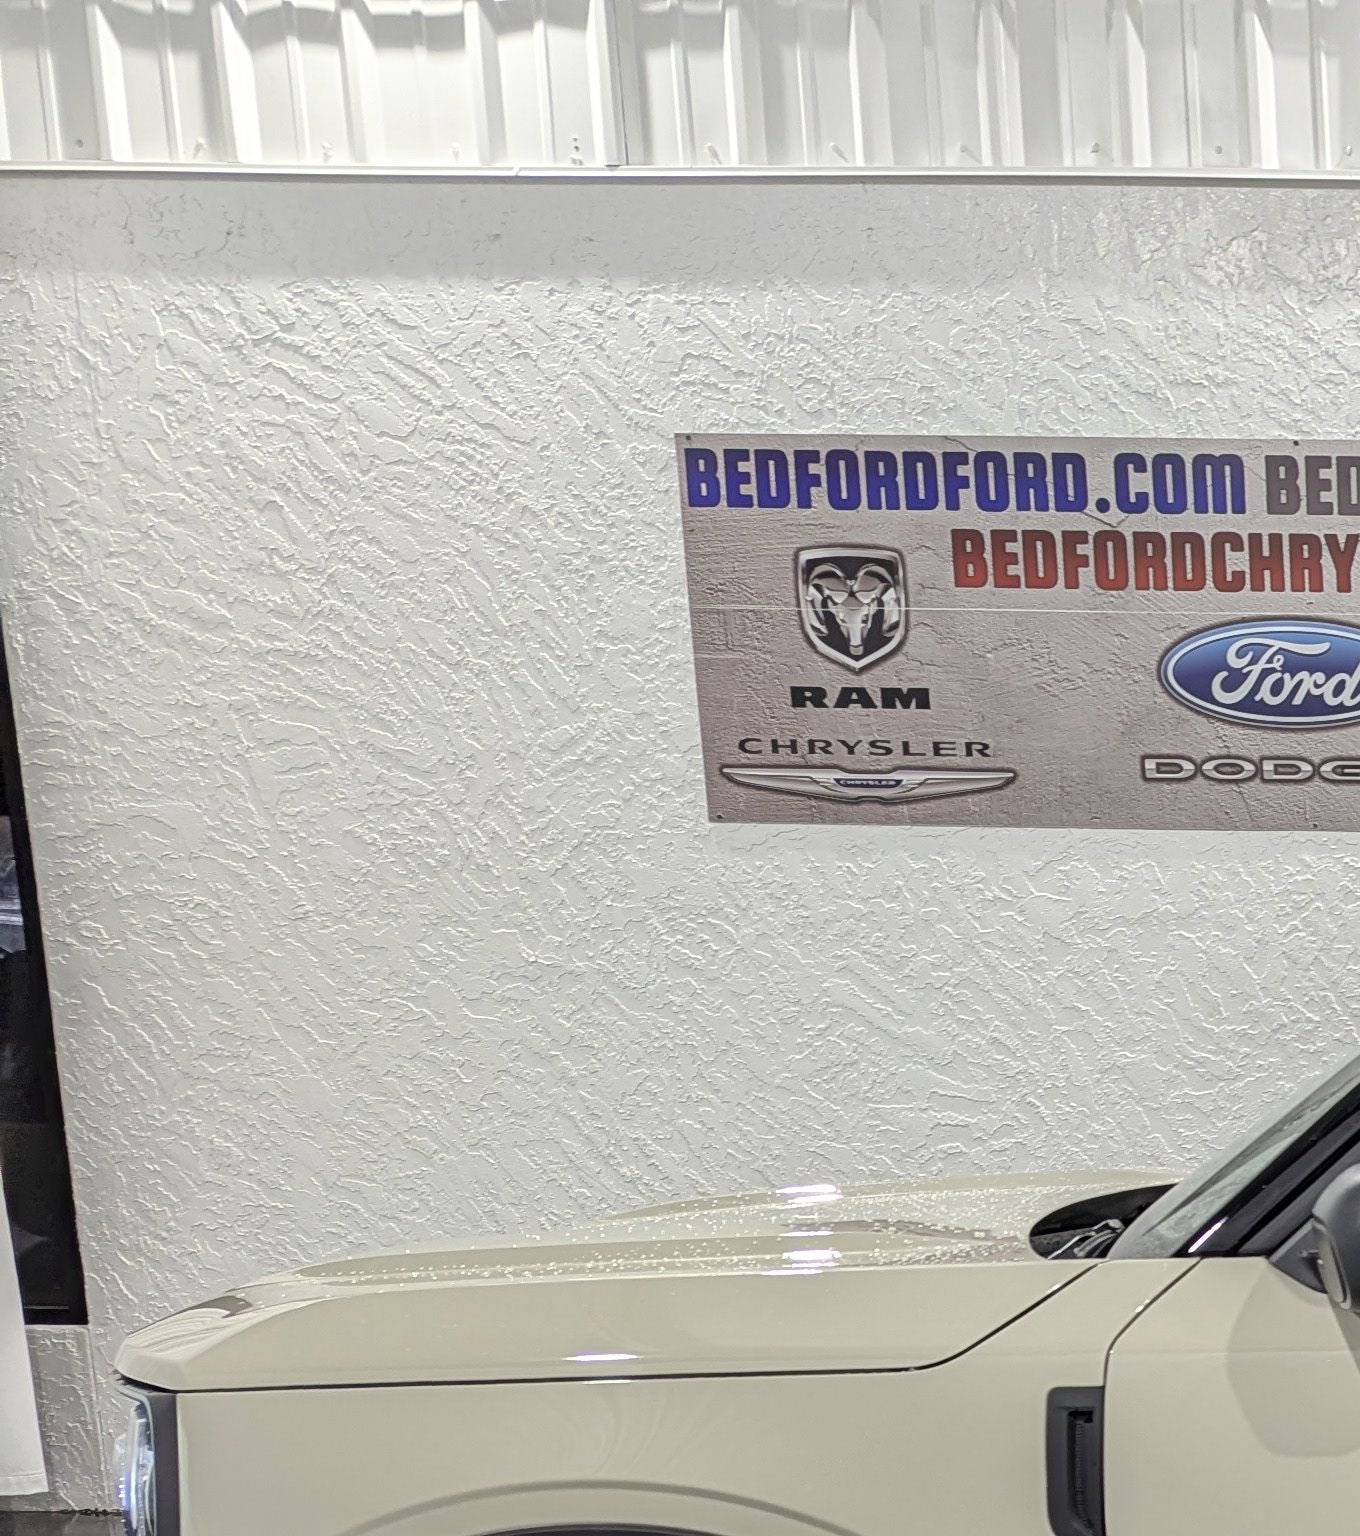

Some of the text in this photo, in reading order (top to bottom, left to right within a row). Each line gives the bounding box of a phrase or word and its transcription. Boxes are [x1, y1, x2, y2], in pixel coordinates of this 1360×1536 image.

[684, 448, 1246, 514] BEDFORDFORD.COM
[790, 685, 931, 710] RAM
[738, 737, 992, 758] CHRYSLER
